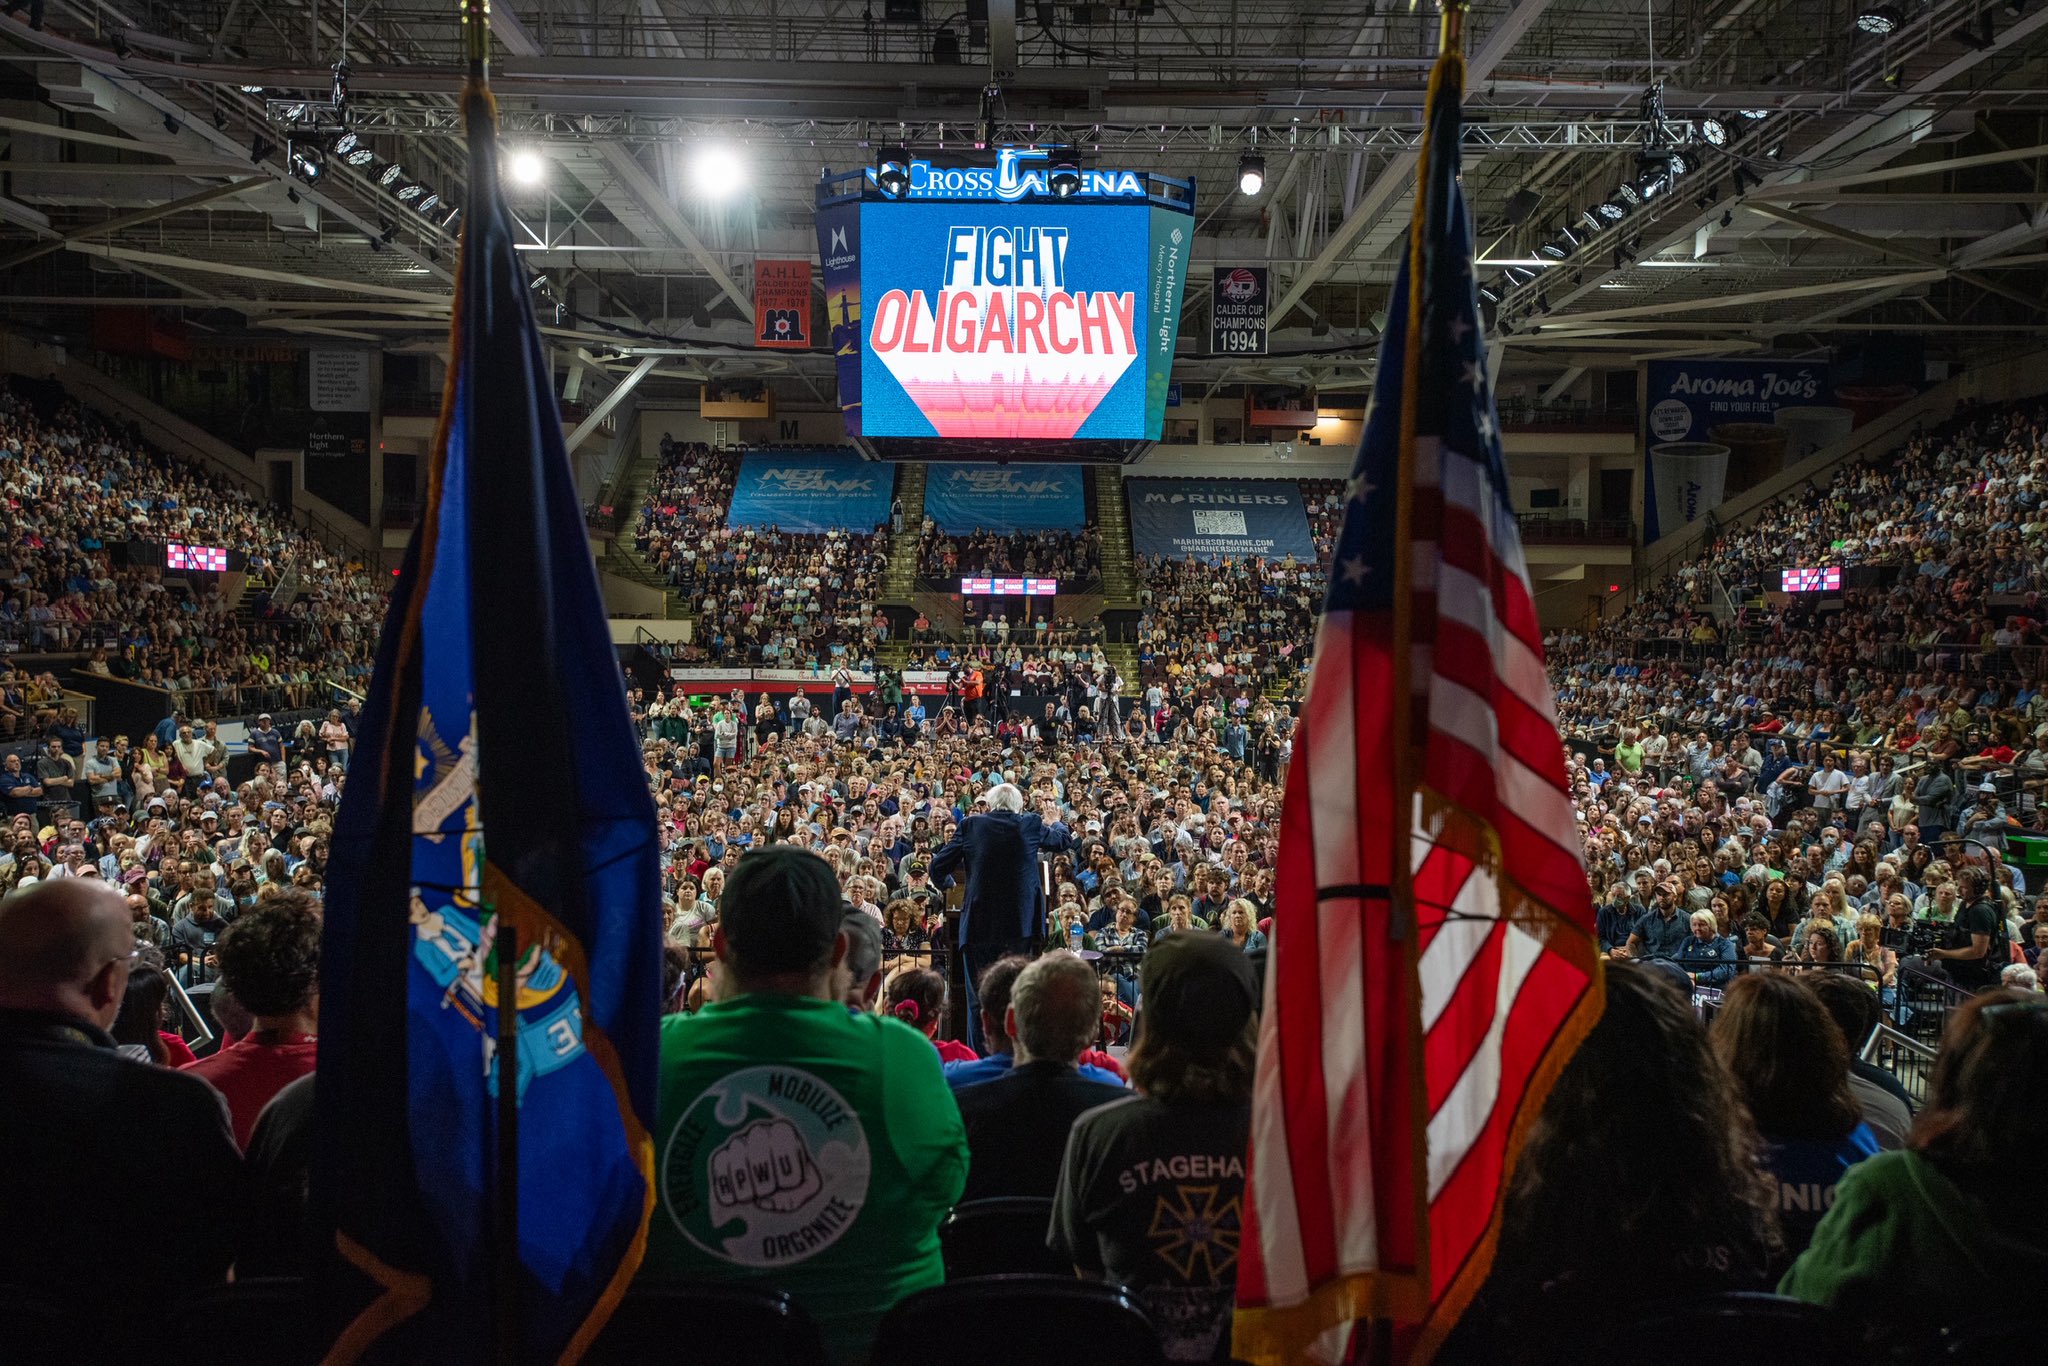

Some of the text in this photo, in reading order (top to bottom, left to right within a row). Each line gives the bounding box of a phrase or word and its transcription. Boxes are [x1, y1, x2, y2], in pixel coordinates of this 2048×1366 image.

[1019, 174, 1142, 193] AENA
[944, 226, 1068, 289] FIGHT
[761, 267, 804, 278] A.H.L.
[756, 280, 809, 288] CALDER CUP
[1153, 244, 1166, 314] Mercy Hospital
[760, 298, 777, 306] 1977
[1158, 247, 1178, 352] Northern Light
[1216, 305, 1264, 315] CALDER CUP
[871, 289, 1137, 355] OLIGARCHY
[1213, 317, 1266, 330] CHAMPIONS
[1220, 331, 1258, 351] 1994
[1669, 372, 1755, 397] Aroma
[1710, 401, 1728, 412] FIND
[1730, 401, 1751, 412] YOUR
[310, 432, 345, 441] Northern
[781, 421, 799, 440] M
[310, 441, 329, 450] Light
[761, 468, 834, 480] NBT
[952, 470, 1022, 481] NBT
[784, 480, 876, 491] BANK
[969, 481, 1064, 493] BANK
[1173, 538, 1274, 547] MARINERSOFMAINE.COM
[1180, 545, 1270, 554] @MARINERSOFMAINE
[768, 1072, 848, 1131] MOBILIZE
[762, 1195, 854, 1259] ORGANIZE
